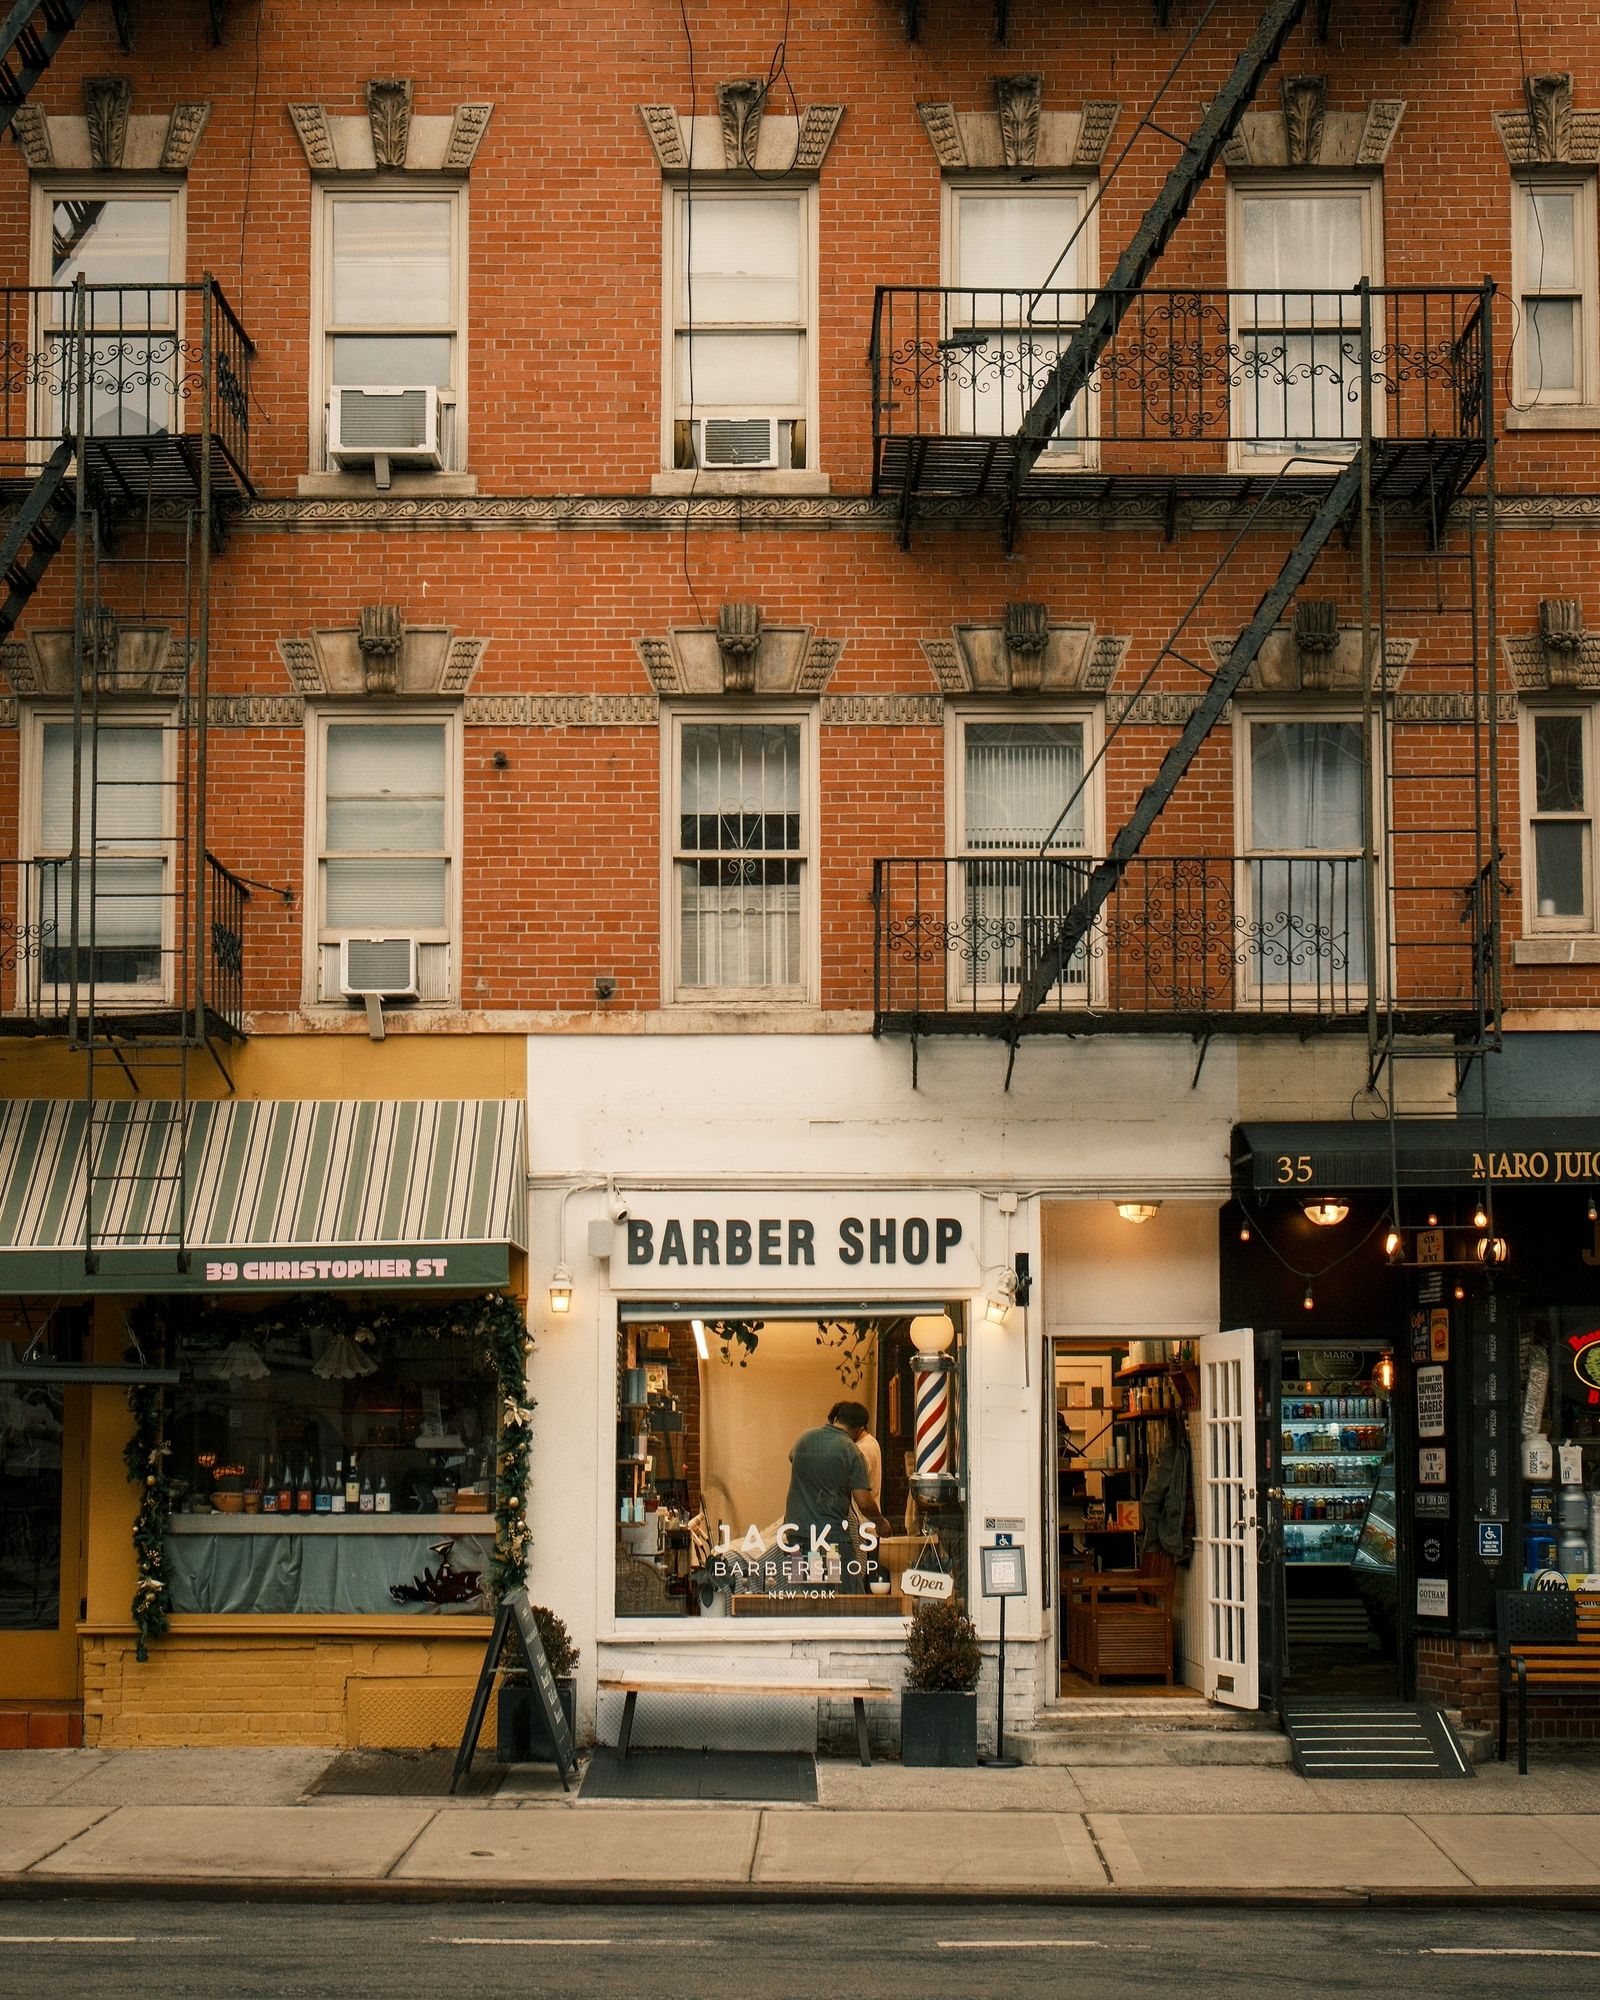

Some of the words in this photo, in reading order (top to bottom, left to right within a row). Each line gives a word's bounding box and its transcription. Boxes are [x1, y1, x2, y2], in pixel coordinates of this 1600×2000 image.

[1277, 1156, 1313, 1183] 35
[1472, 1151, 1549, 1178] MARO
[627, 1219, 815, 1266] BARBER
[839, 1217, 963, 1265] SHOP
[207, 1262, 238, 1281] 39
[243, 1259, 411, 1280] CHRISTOPHER
[416, 1258, 448, 1277] ST
[1323, 1351, 1354, 1361] MARO
[1420, 1400, 1443, 1413] BAGELS
[1529, 1451, 1538, 1474] ISOPURE
[714, 1520, 878, 1552] JACK'S
[714, 1560, 879, 1577] BARBERSHOP
[909, 1573, 945, 1591] Open
[768, 1590, 796, 1600] NEW
[802, 1590, 836, 1600] YORK
[1419, 1590, 1446, 1599] GOTHAM
